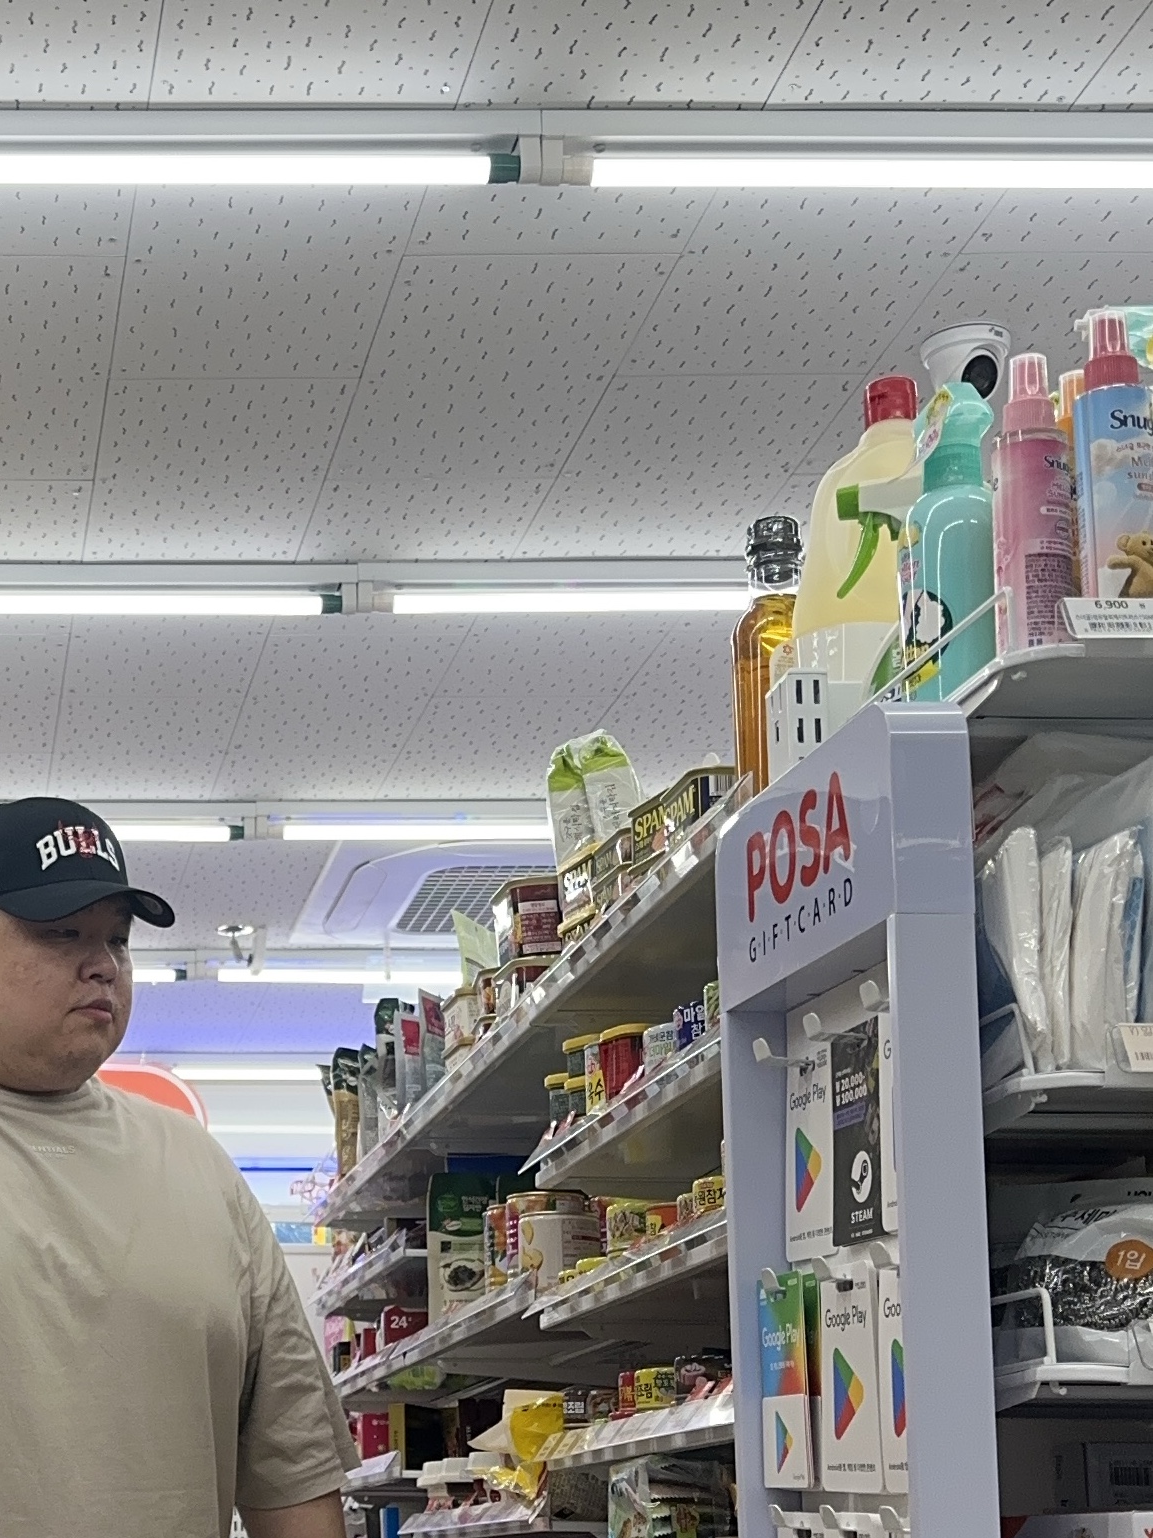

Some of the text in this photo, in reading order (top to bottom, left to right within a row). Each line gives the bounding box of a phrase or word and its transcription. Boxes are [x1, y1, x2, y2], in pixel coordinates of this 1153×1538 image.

[1095, 601, 1129, 610] 6,900
[36, 826, 120, 871] BULLS
[747, 771, 852, 923] POSA
[789, 1084, 827, 1112] Google Play
[850, 1207, 874, 1225] STEAM
[390, 1316, 408, 1329] 24
[825, 1305, 867, 1331] Google Play
[762, 1327, 786, 1351] Google
